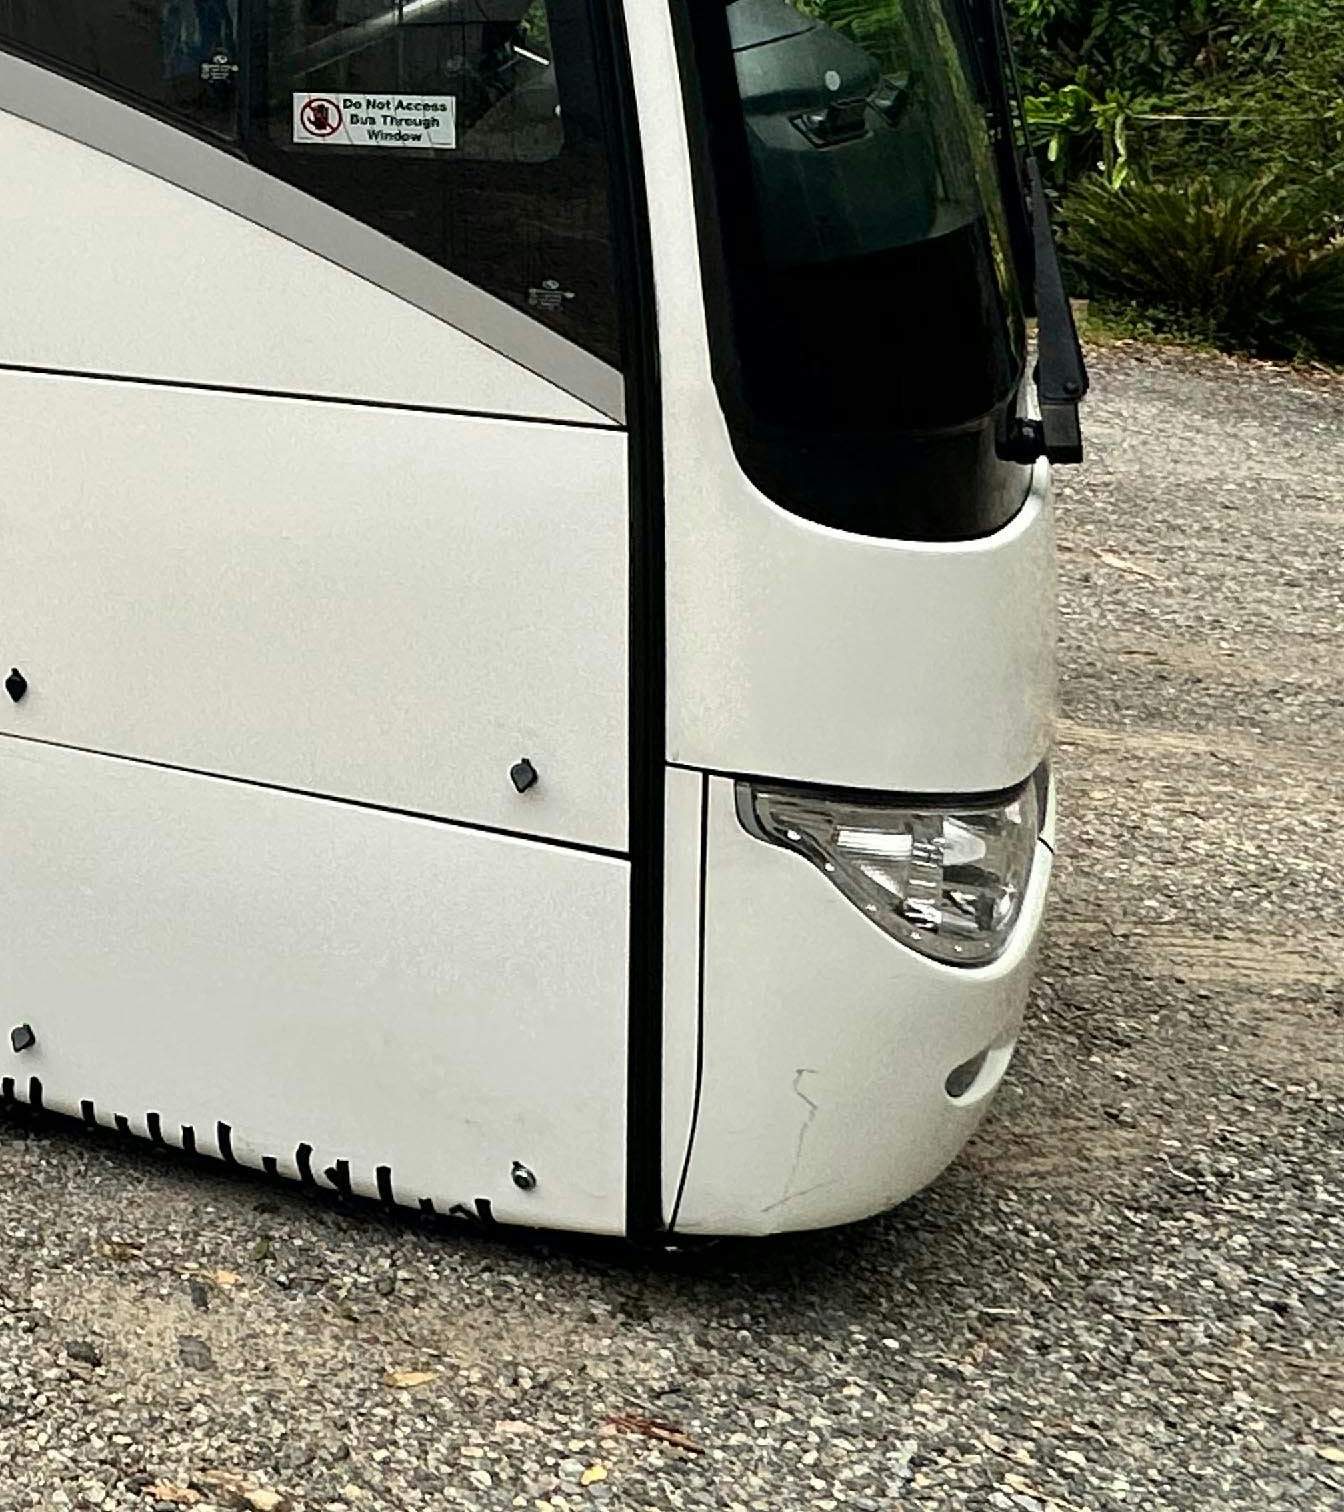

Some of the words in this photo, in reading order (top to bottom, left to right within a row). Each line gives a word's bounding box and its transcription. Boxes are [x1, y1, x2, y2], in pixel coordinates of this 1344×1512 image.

[342, 98, 362, 110] Do
[366, 98, 392, 111] Not
[395, 99, 448, 112] Access
[350, 114, 377, 126] Bus
[381, 114, 440, 130] Through
[367, 129, 423, 142] Window
